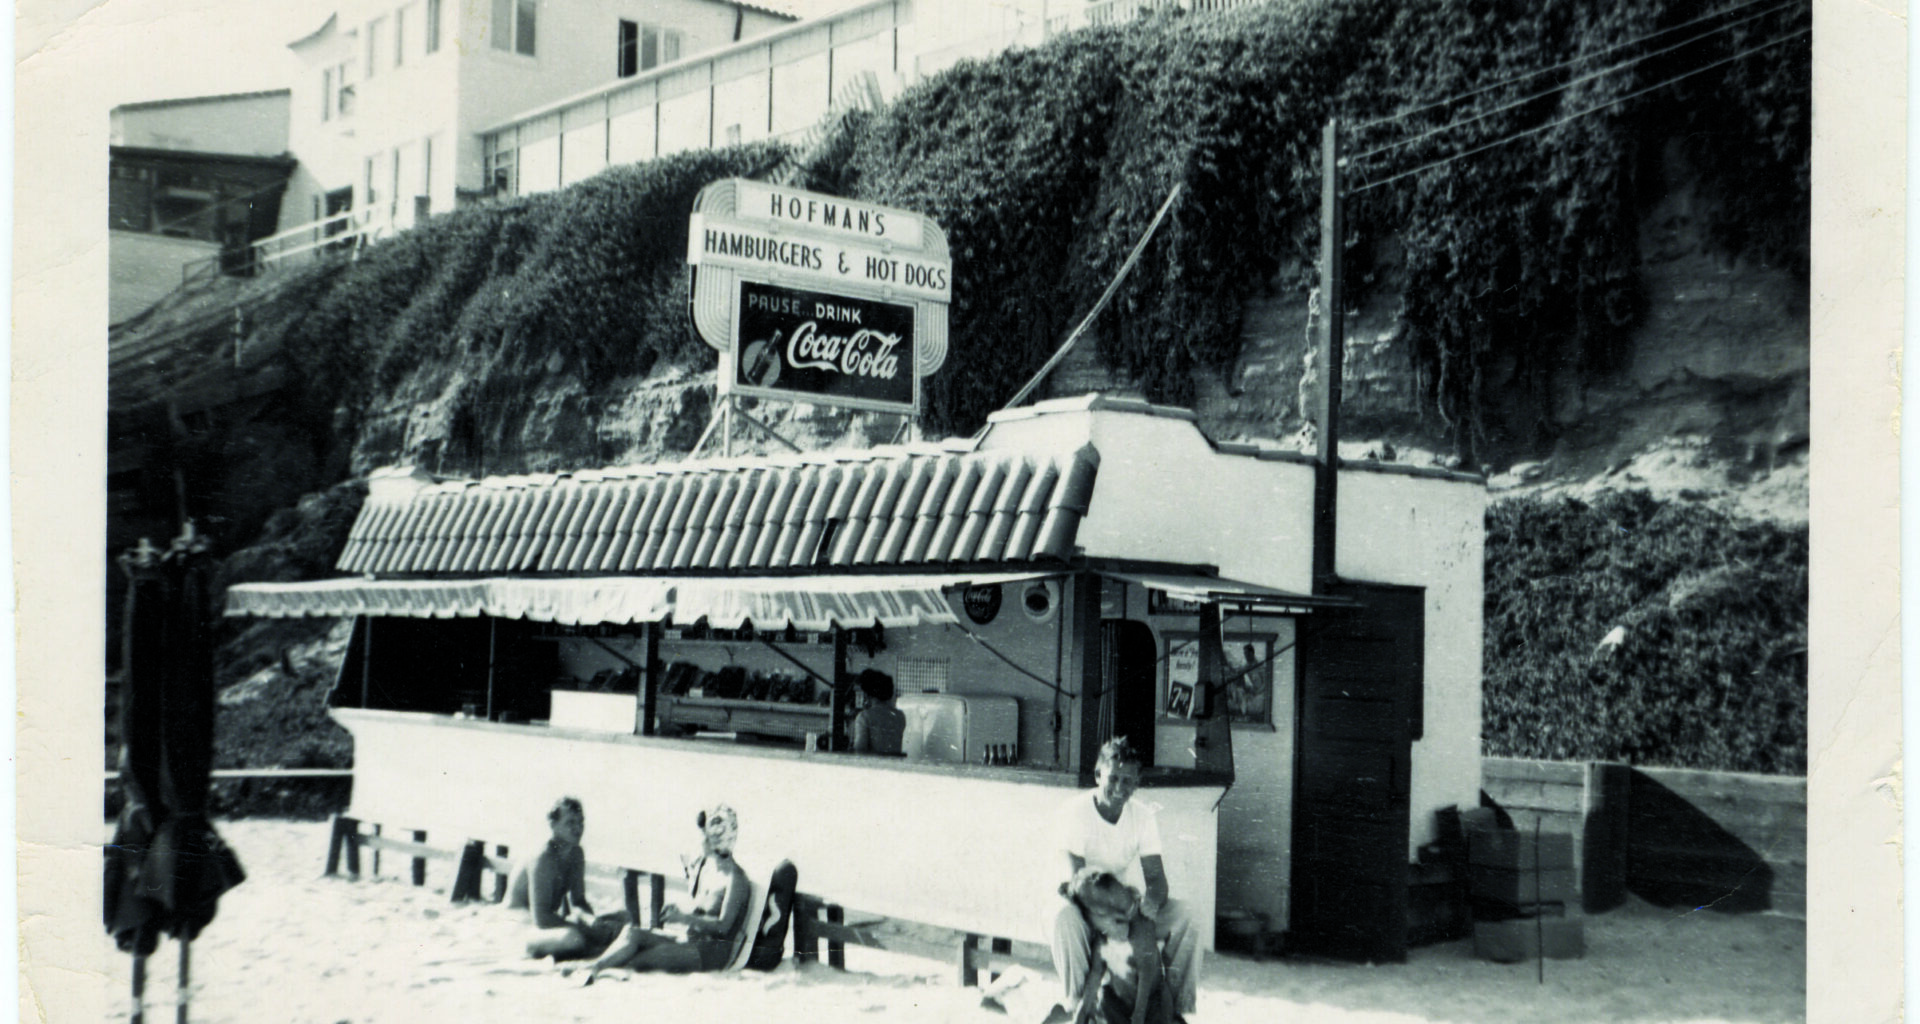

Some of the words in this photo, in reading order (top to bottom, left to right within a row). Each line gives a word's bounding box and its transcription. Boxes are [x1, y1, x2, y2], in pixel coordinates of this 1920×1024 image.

[770, 193, 886, 236] HOFMAN'S
[705, 229, 823, 271] HAMBURGERS
[838, 251, 850, 275] &
[866, 256, 899, 283] HOT
[905, 263, 947, 290] DOGS
[815, 303, 862, 325] DRINK
[786, 321, 903, 380] Coca-Cola
